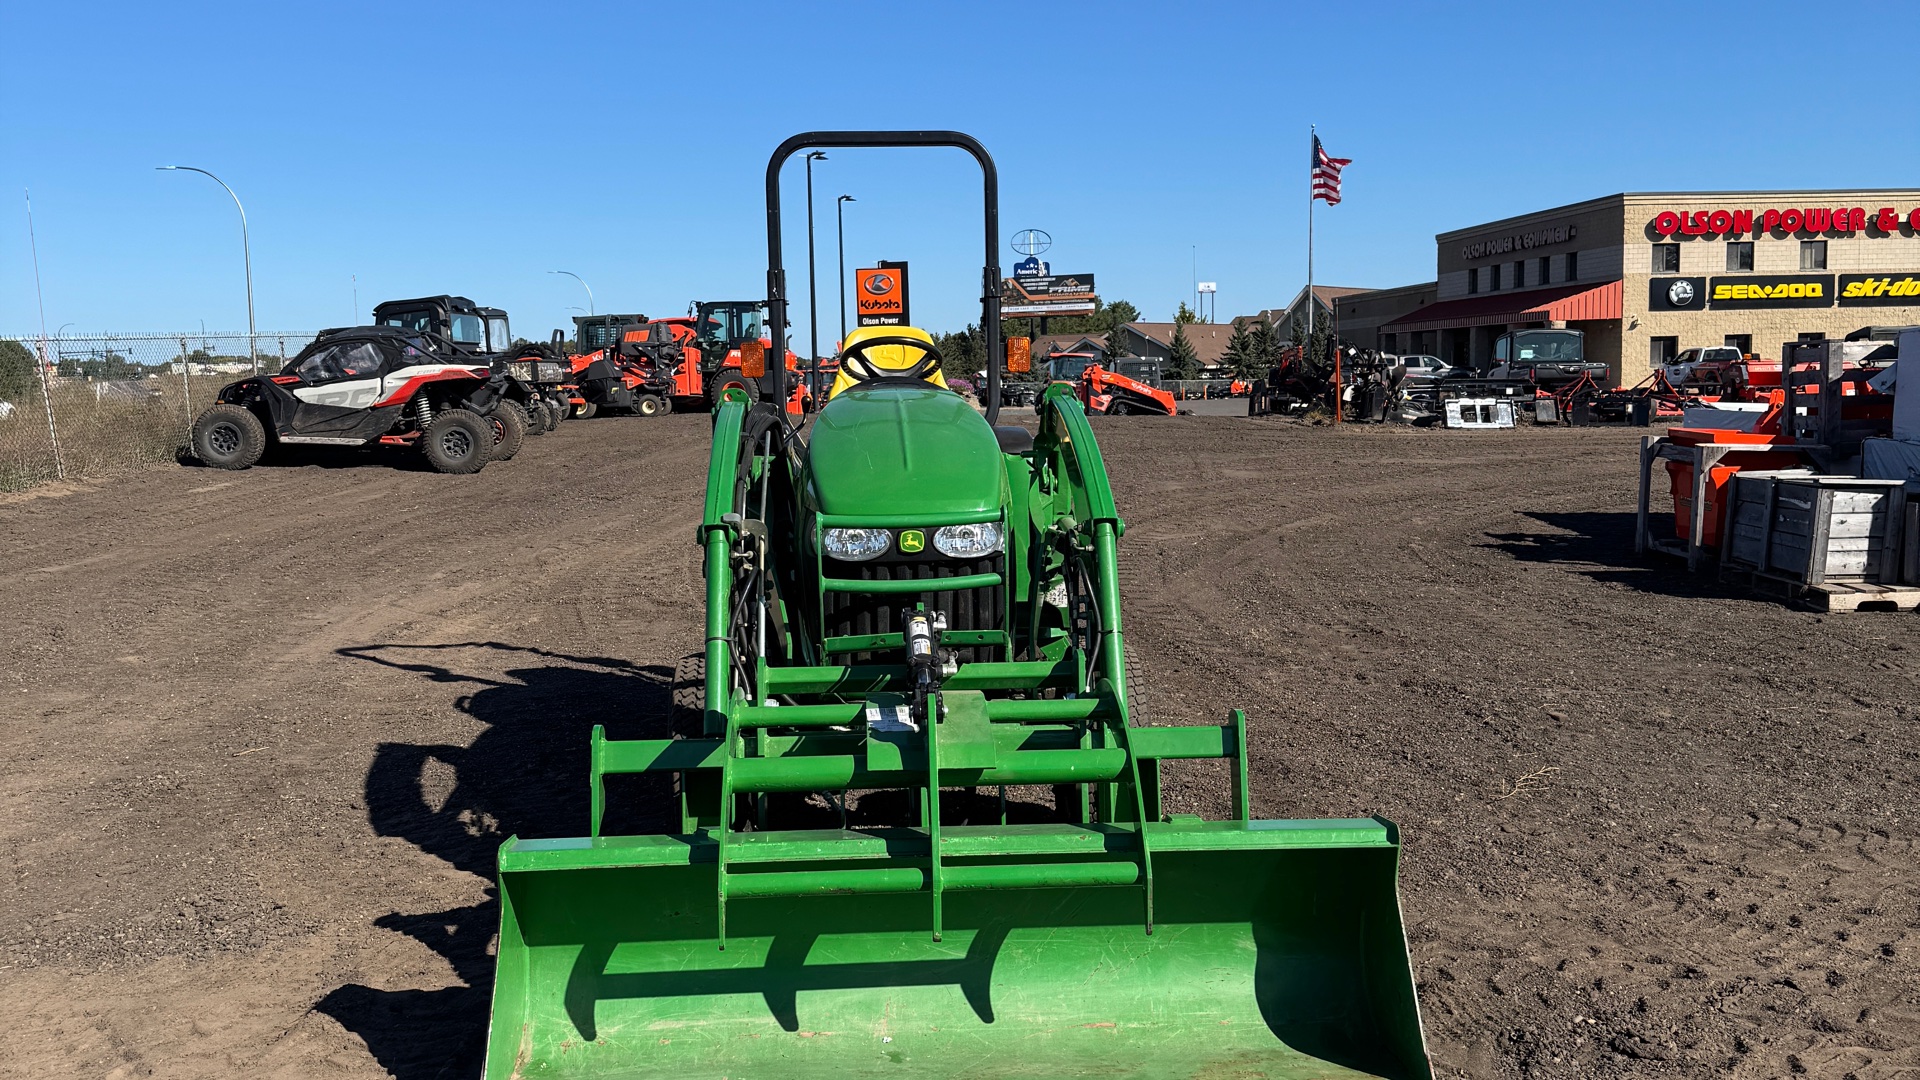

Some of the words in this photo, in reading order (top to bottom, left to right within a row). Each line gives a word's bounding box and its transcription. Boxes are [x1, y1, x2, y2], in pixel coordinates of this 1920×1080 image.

[1655, 210, 1753, 236] OLSON
[1763, 207, 1866, 233] POWER
[1877, 208, 1899, 232] &
[1462, 242, 1485, 260] OLSON
[1486, 237, 1513, 256] POWER
[1514, 235, 1522, 250] &
[1523, 225, 1571, 249] EQUIPMENT
[860, 299, 900, 310] Kubota
[862, 317, 879, 325] Olson
